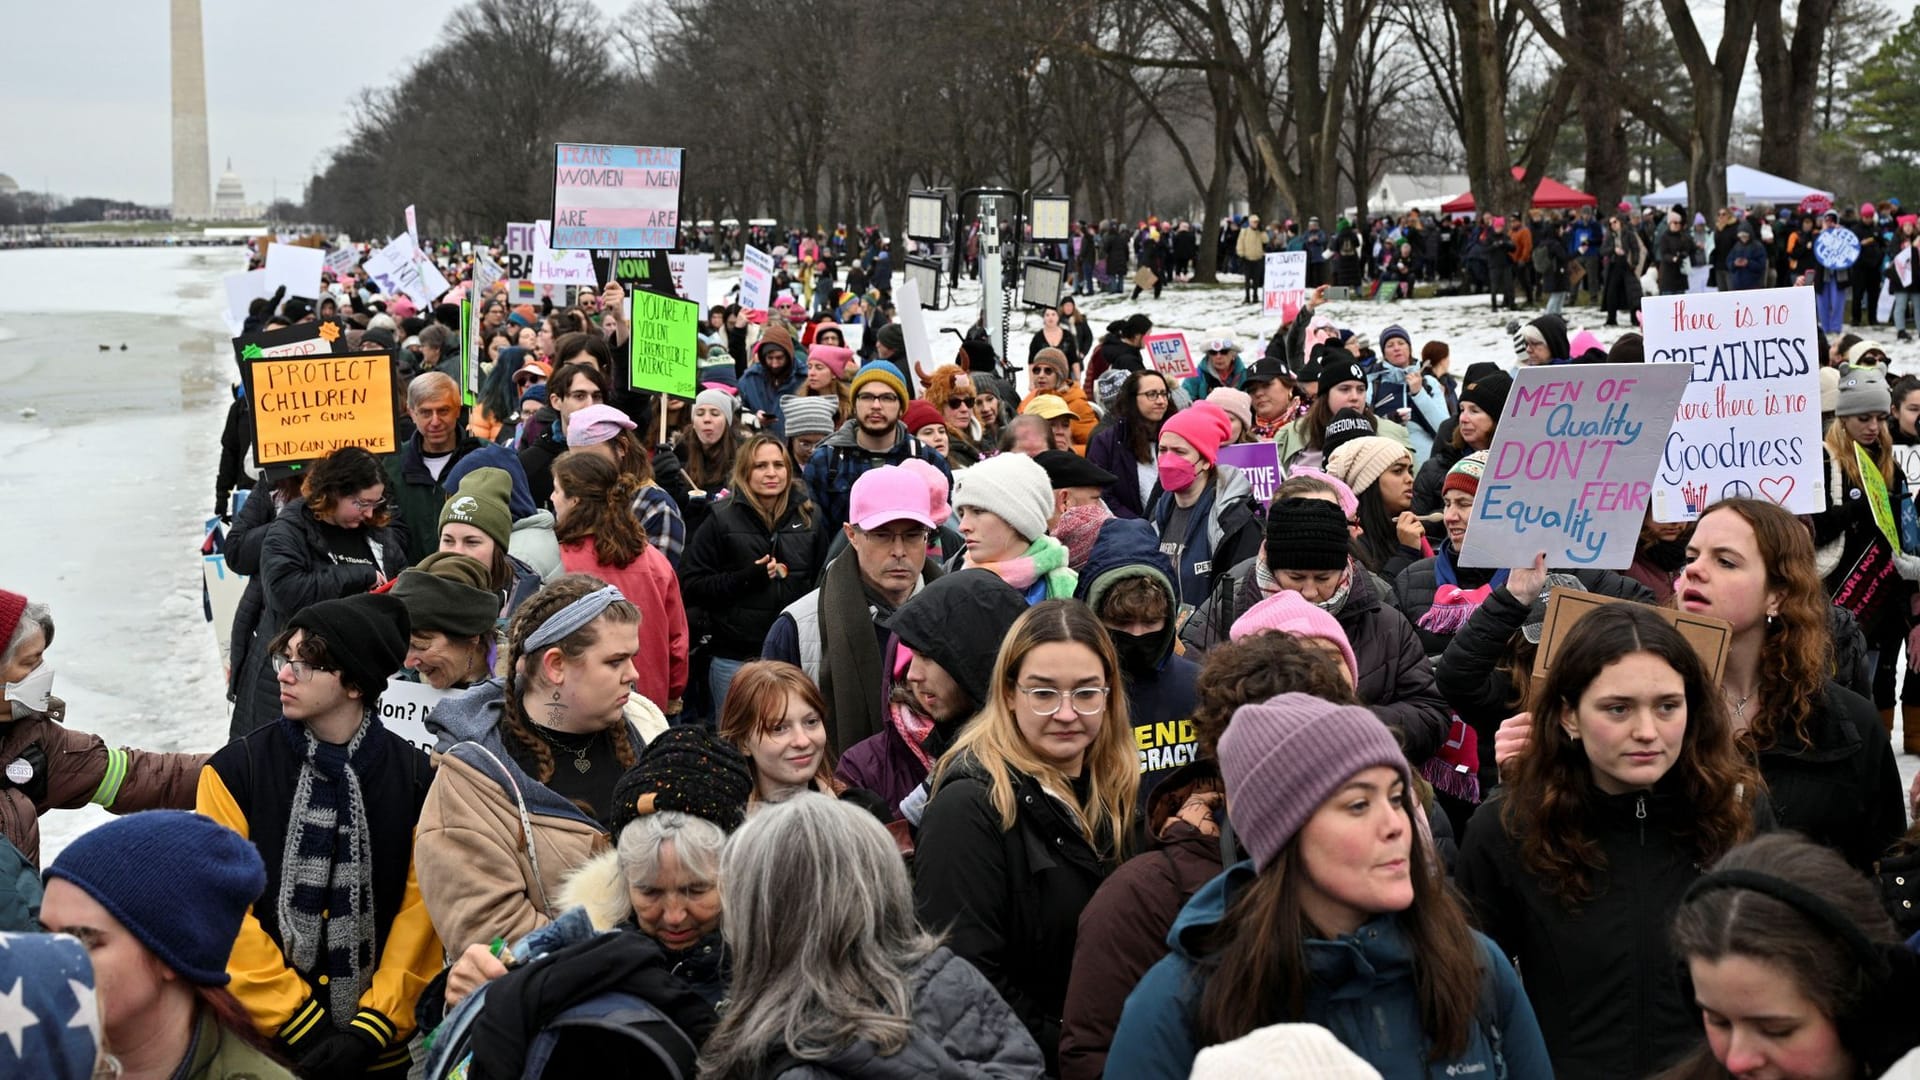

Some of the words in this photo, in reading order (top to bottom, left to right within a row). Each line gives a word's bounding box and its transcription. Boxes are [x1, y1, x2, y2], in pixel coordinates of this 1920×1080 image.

[561, 147, 612, 165] TRANS
[635, 149, 680, 167] TRANS
[558, 168, 623, 187] WOMEN
[645, 170, 679, 188] MEN
[558, 210, 587, 227] ARE
[648, 211, 676, 227] ARE
[556, 230, 618, 246] WOMEN
[641, 230, 676, 246] MEN
[539, 262, 579, 279] Human
[617, 259, 650, 278] NOW
[640, 293, 660, 320] YOU
[662, 300, 678, 322] ARE
[683, 305, 690, 324] A
[1671, 300, 1721, 332] there
[1735, 302, 1758, 329] is
[1764, 304, 1789, 325] no
[639, 320, 669, 343] VIOLENT
[1151, 340, 1181, 354] HELP
[267, 360, 377, 389] PROTECT
[638, 356, 673, 378] MIRACLE
[1158, 359, 1190, 373] HATE
[261, 387, 367, 413] CHILDREN
[1511, 380, 1584, 417] MEN
[1596, 379, 1637, 403] OF
[1675, 400, 1713, 422] ere
[1715, 383, 1759, 418] there
[1766, 389, 1781, 416] is
[1785, 394, 1807, 413] no
[281, 413, 310, 426] NOT
[320, 411, 355, 422] GUNS
[1545, 402, 1643, 445] Quality
[264, 441, 297, 458] END
[300, 439, 325, 451] GUN
[327, 436, 387, 450] VIOLENCE
[1662, 427, 1803, 485] Goodness
[1493, 439, 1623, 481] DON'T
[1578, 481, 1651, 512] FEAR
[1480, 485, 1607, 563] Equality
[1860, 544, 1880, 572] NOT
[1862, 577, 1879, 603] NOT
